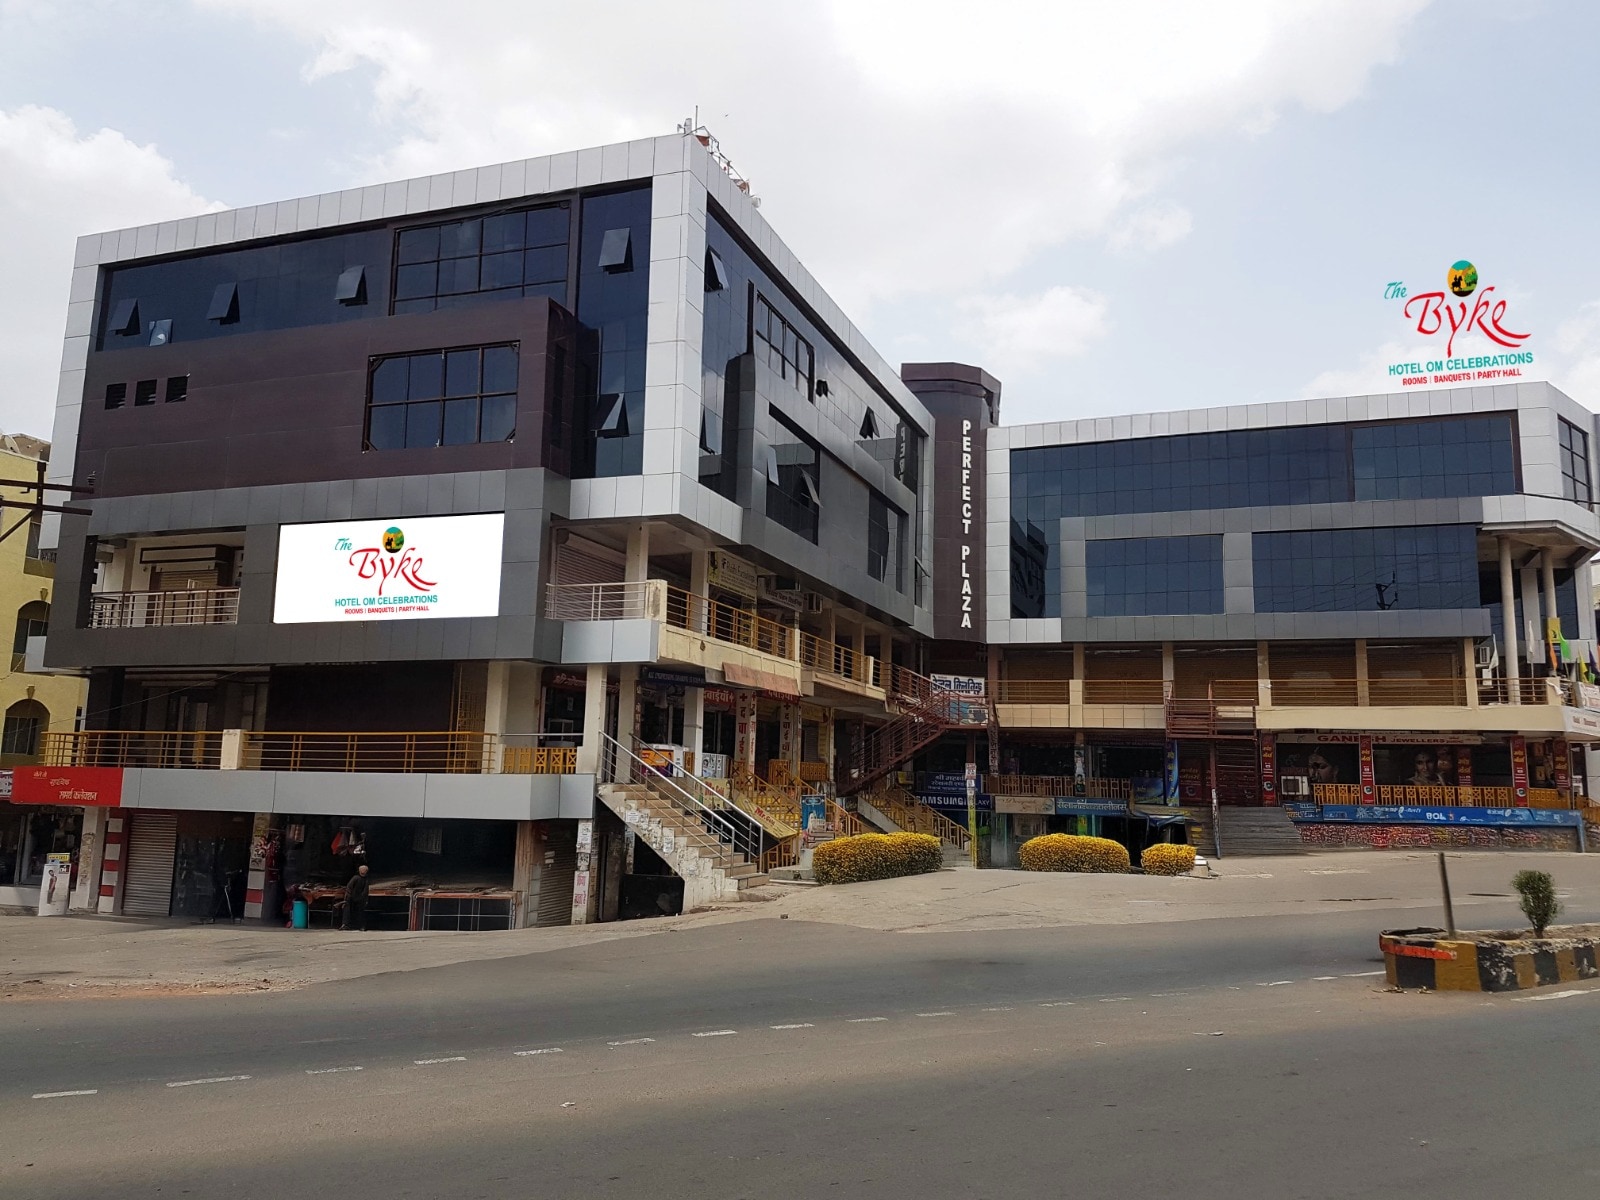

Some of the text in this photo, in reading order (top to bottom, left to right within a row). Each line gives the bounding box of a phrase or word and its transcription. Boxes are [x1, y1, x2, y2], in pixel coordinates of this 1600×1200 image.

[1383, 281, 1408, 300] The
[1404, 286, 1532, 358] Byke
[1388, 352, 1534, 376] HOTEL OM CELEBRATIONS
[1402, 368, 1522, 386] ROOMS BANQUETS PARTY HALL
[960, 419, 972, 629] PERFECT PLAZA
[334, 537, 353, 551] The
[349, 547, 438, 596] Byke
[334, 594, 438, 607] HOTEL OM CELEBRATIONS
[915, 795, 965, 806] SAMSUNG
